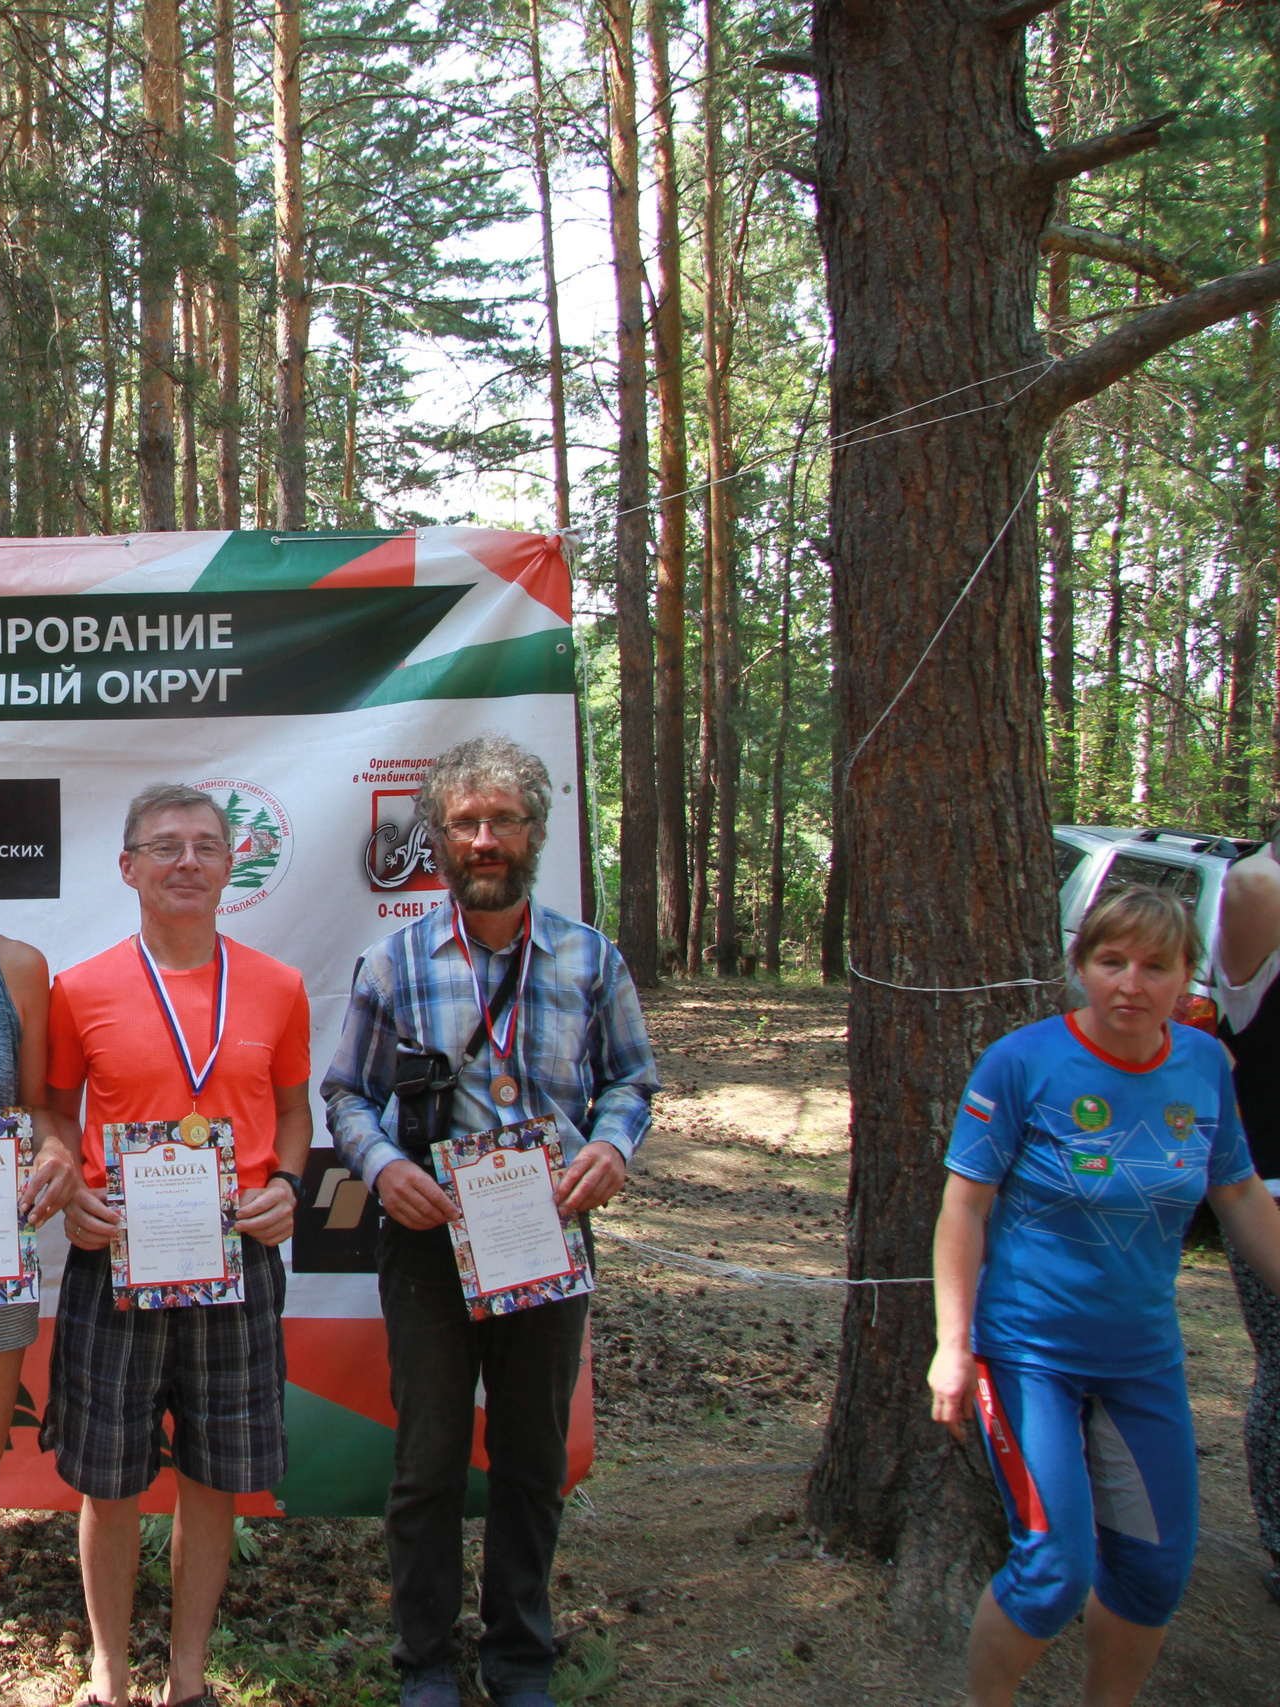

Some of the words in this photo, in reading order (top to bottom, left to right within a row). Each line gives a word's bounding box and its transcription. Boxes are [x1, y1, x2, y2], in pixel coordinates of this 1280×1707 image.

[97, 668, 242, 703] ОКРУГ
[353, 774, 358, 783] в
[362, 771, 426, 783] Челябинской
[194, 780, 235, 791] ТИВНОГО
[236, 780, 289, 837] ОРИЕНТИРОВАНИЯ
[226, 889, 268, 914] ОБЛАСТИ
[134, 1162, 207, 1178] ГРАМОТА
[1079, 1157, 1103, 1168] SFR
[467, 1163, 538, 1190] ГРАМОТА
